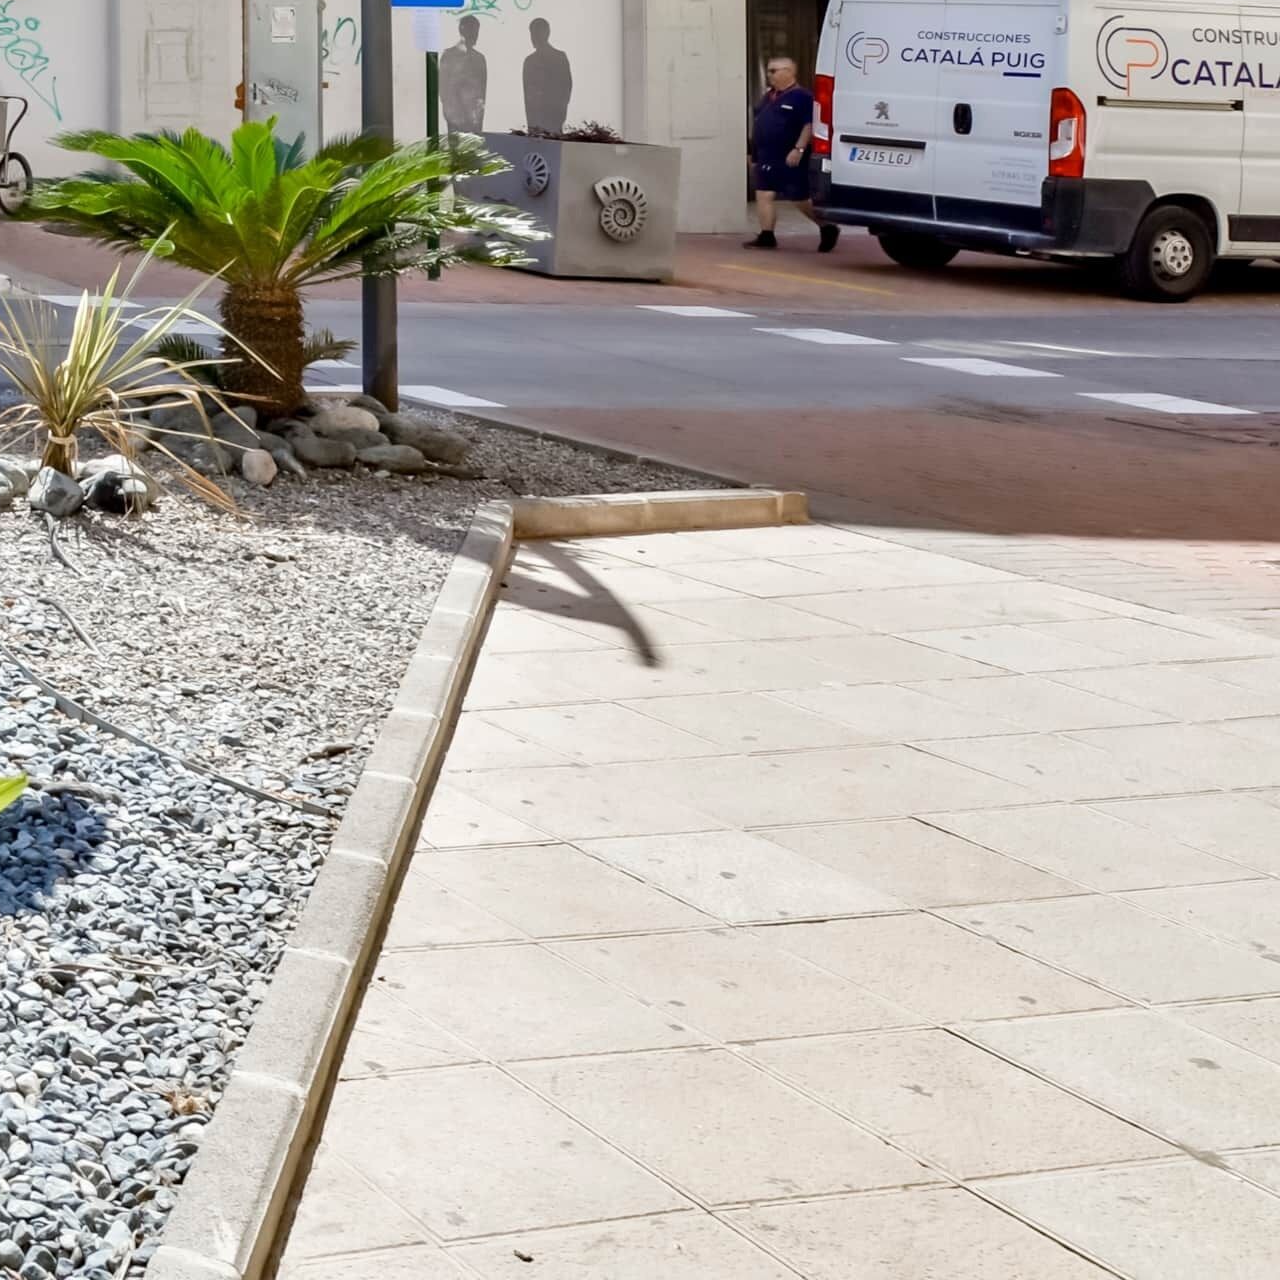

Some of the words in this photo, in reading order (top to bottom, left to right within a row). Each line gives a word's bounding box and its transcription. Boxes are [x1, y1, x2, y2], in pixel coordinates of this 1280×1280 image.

[917, 30, 1032, 44] CONSTRUCCIONES
[900, 47, 985, 66] CATALÁ
[991, 51, 1046, 69] PUIG
[857, 149, 885, 162] 2415
[888, 151, 913, 166] LGJ
